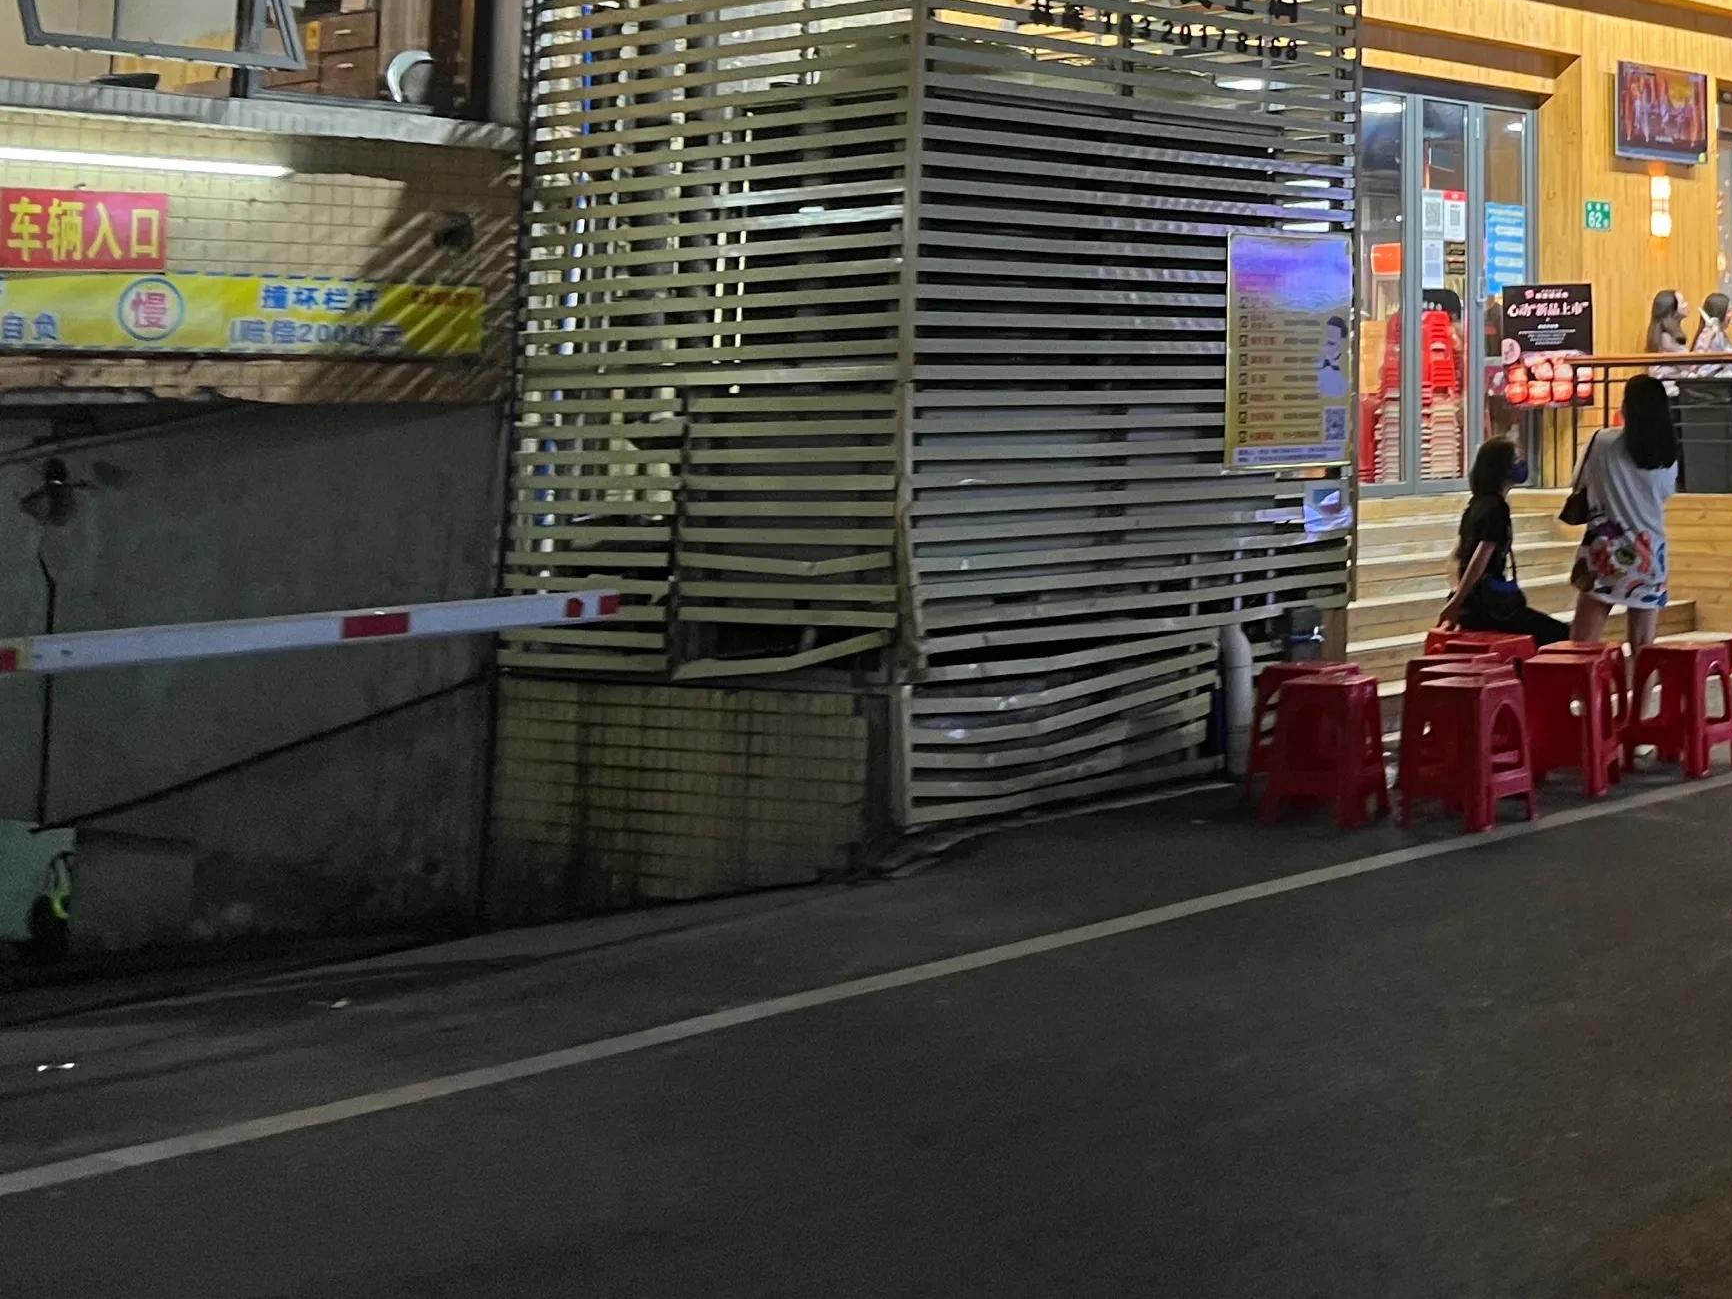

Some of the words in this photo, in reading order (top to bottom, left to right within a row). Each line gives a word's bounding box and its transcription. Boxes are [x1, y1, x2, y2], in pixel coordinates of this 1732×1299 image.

[7, 196, 160, 262] 车辆入口
[130, 292, 169, 330] 慢
